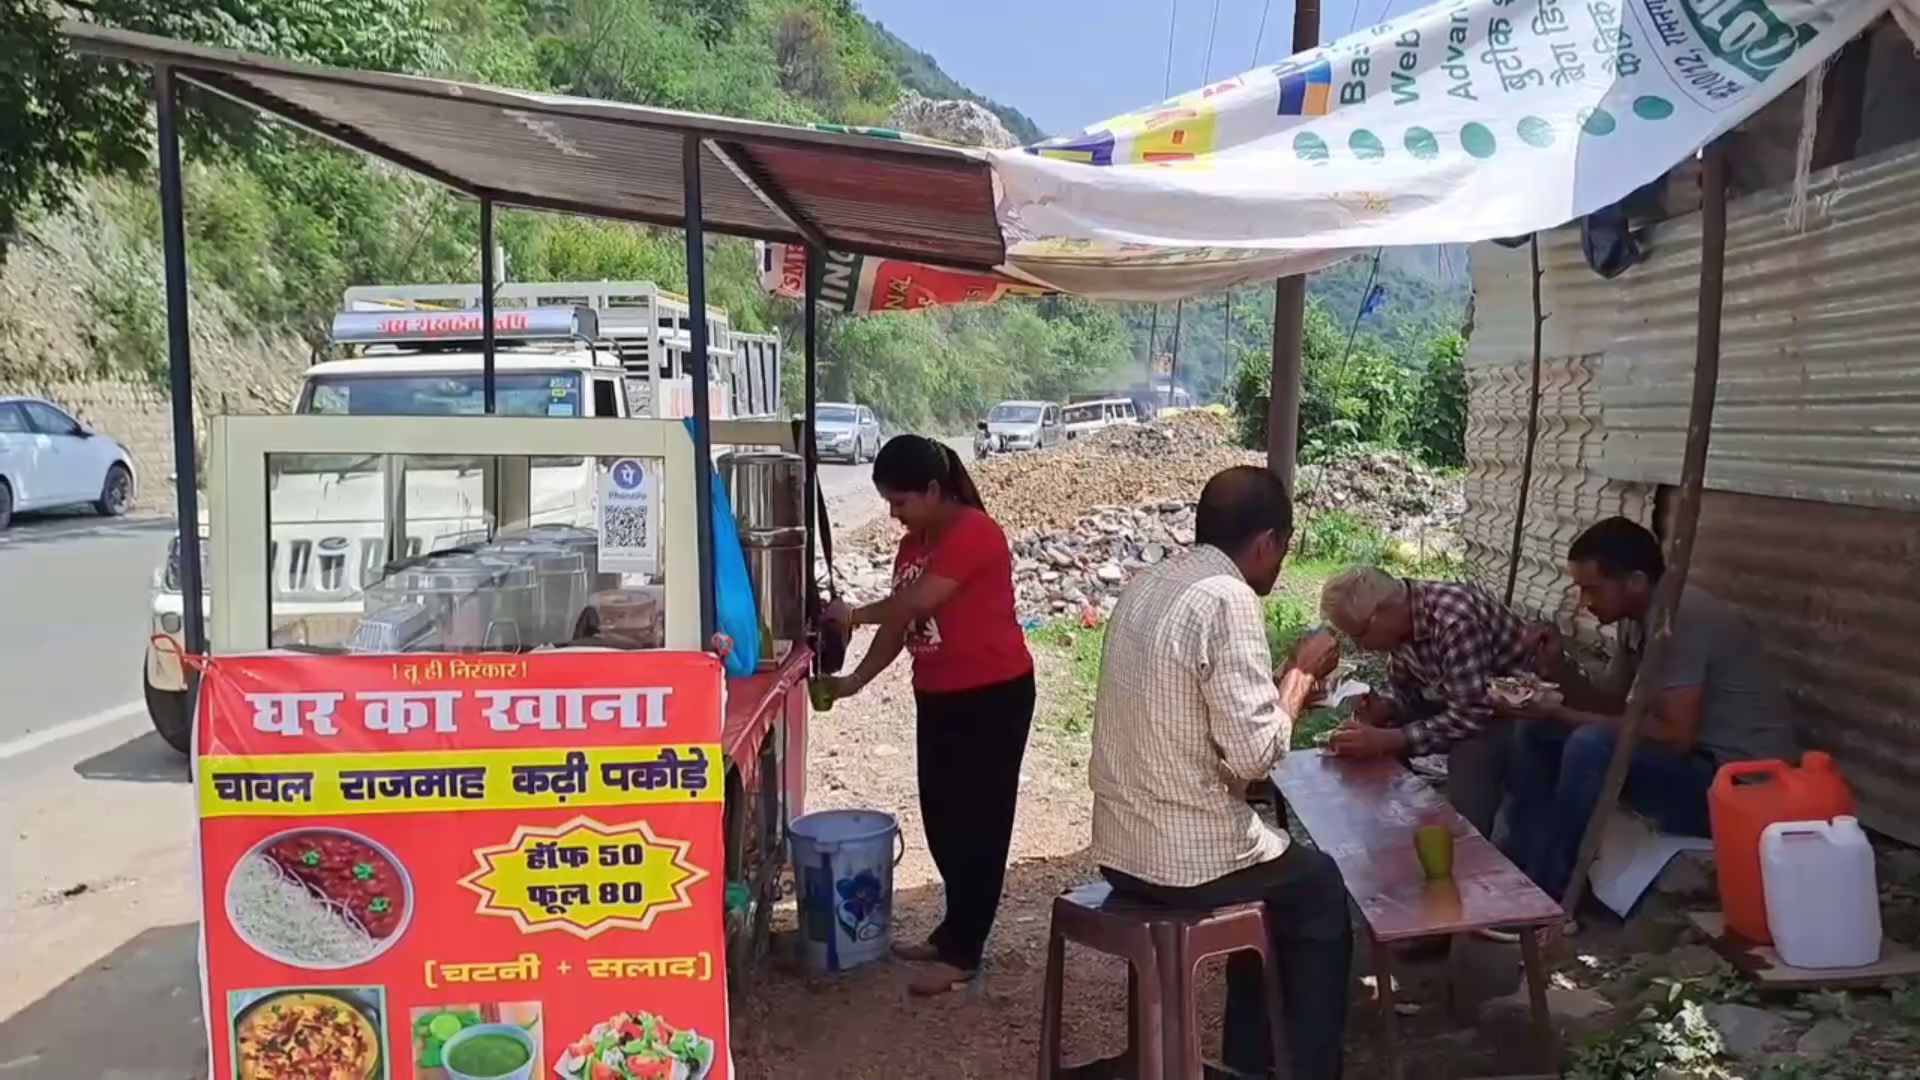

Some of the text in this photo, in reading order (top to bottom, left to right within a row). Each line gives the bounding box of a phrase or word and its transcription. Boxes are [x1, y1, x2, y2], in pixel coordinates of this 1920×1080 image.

[1391, 28, 1421, 105] Web
[1480, 17, 1544, 92] बुटीक
[1532, 0, 1585, 87] बैग डि
[404, 664, 421, 686] तू
[424, 659, 442, 680] ही
[450, 659, 516, 679] निरंकार
[245, 687, 673, 736] घर का खाना
[212, 747, 708, 803] चावल राजमाह कढ़ी पकौड़े
[524, 841, 643, 870] हॉफ 50
[527, 882, 643, 914] फूल 80
